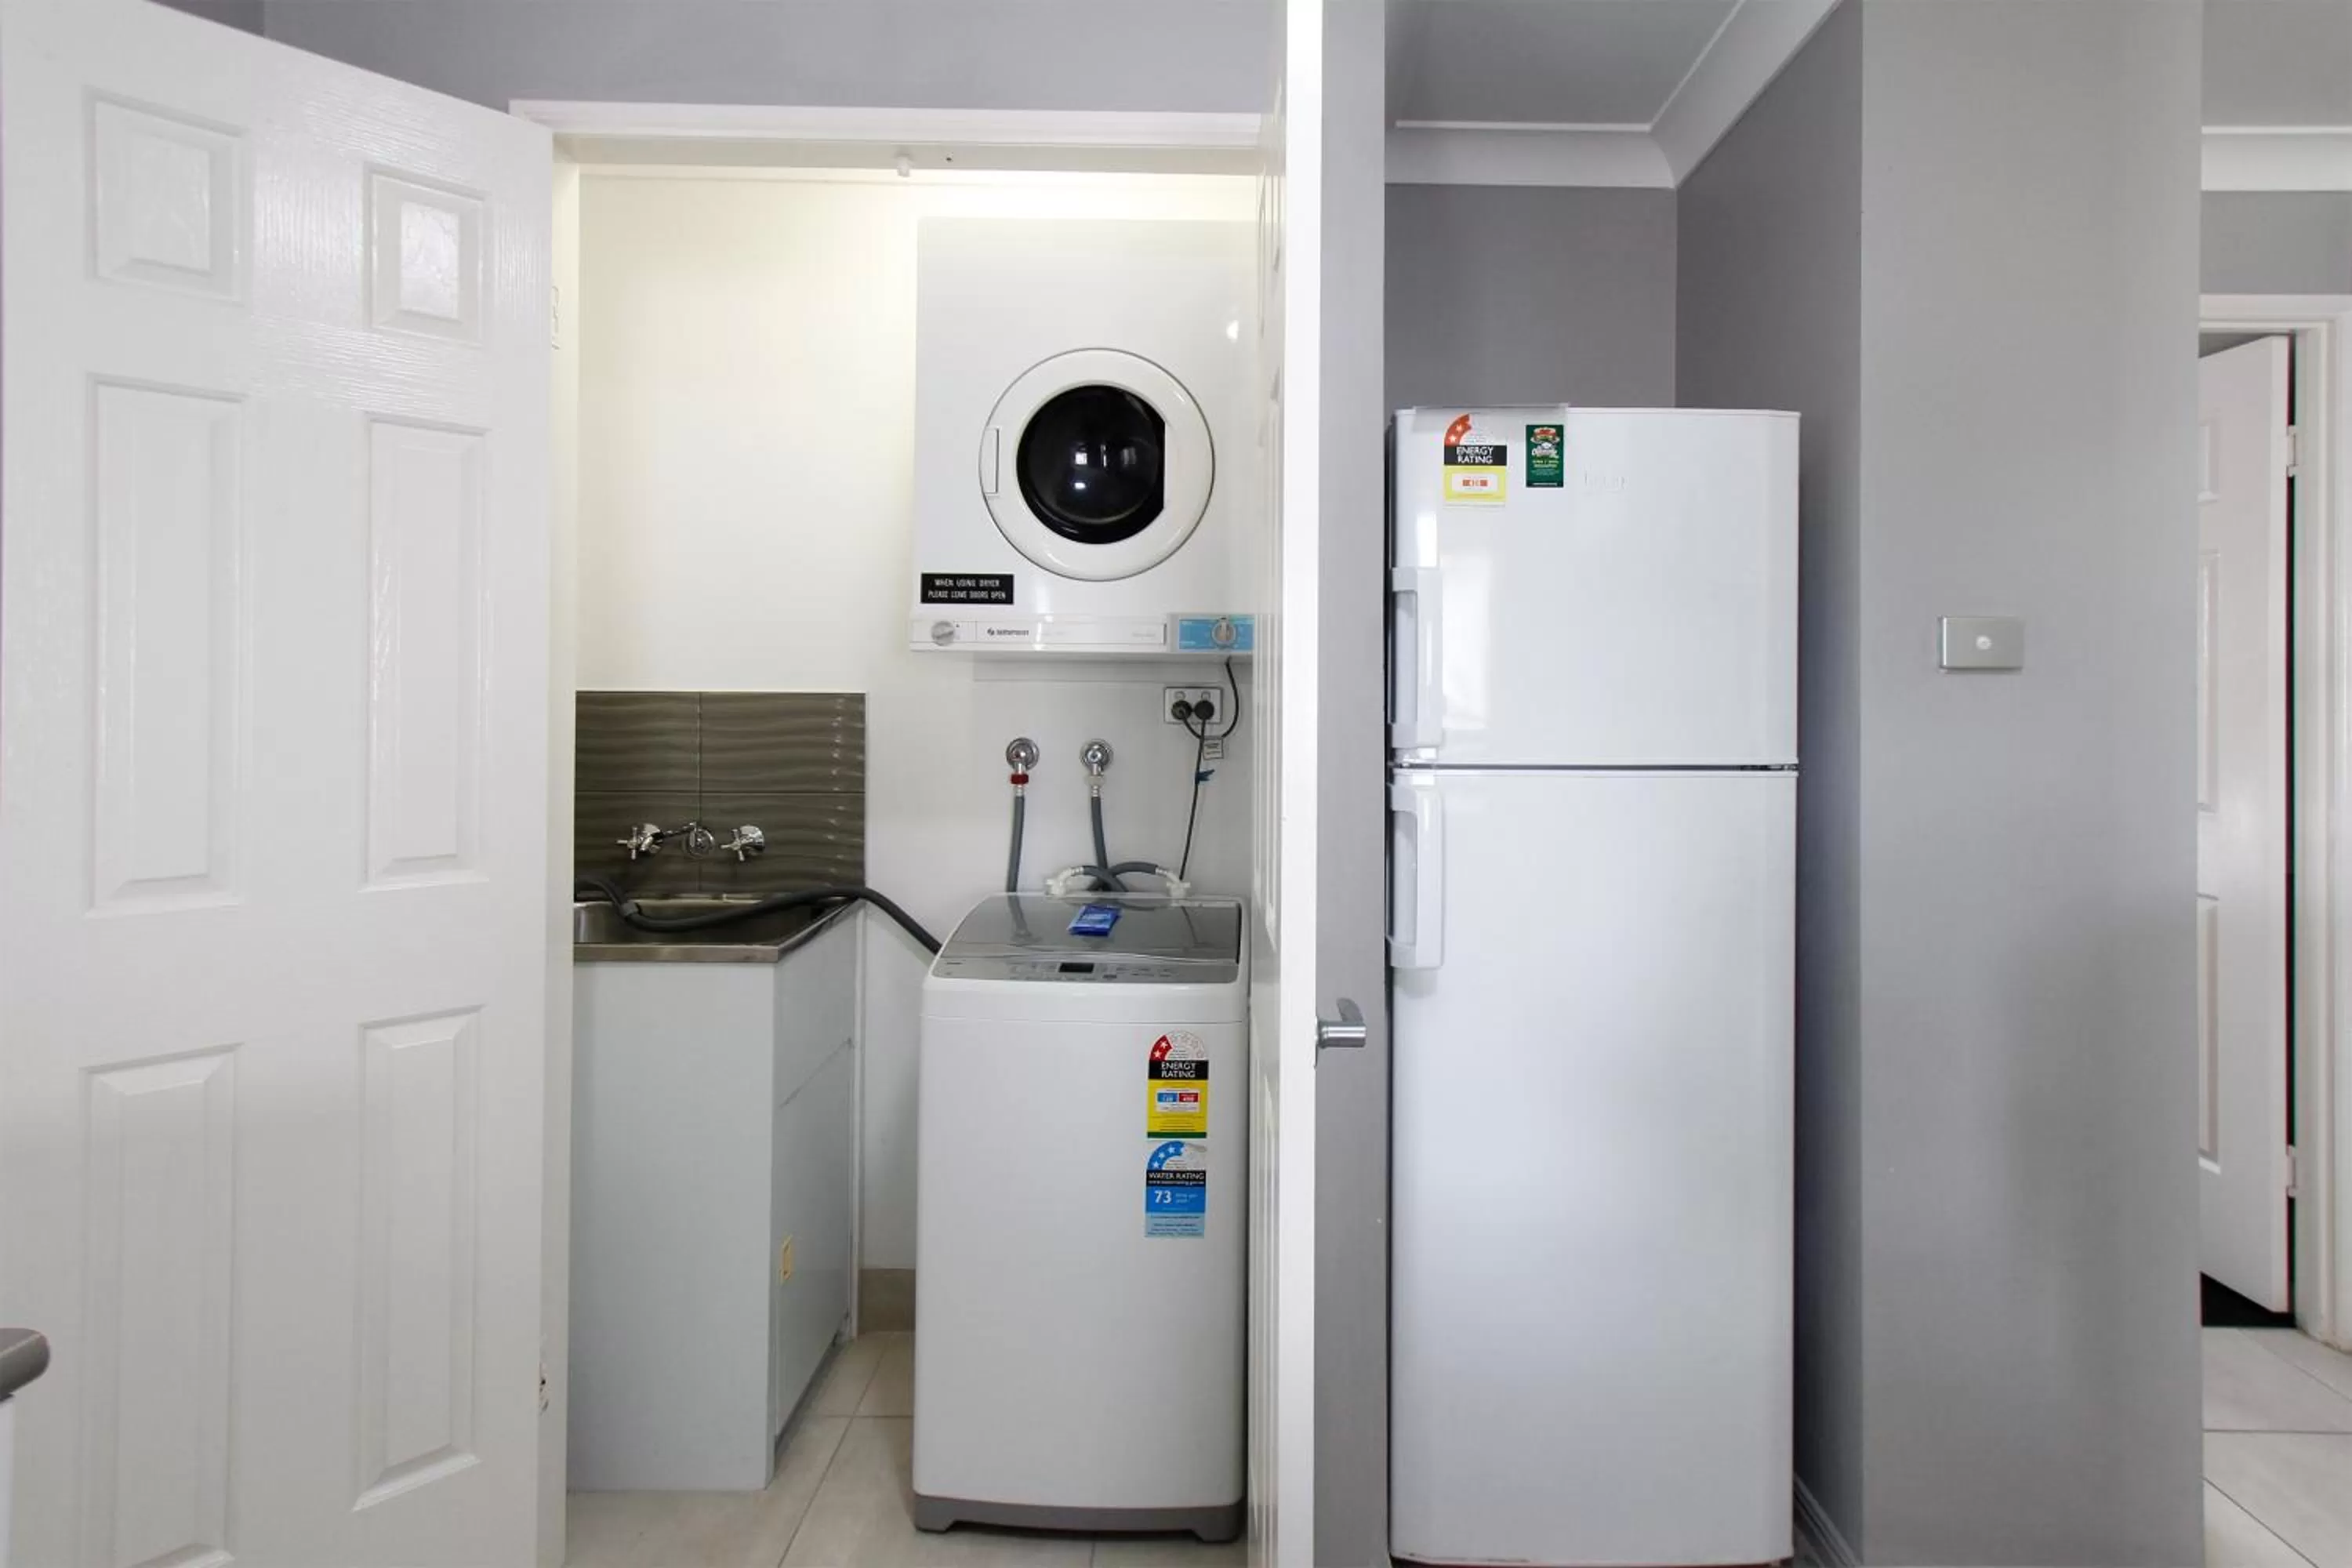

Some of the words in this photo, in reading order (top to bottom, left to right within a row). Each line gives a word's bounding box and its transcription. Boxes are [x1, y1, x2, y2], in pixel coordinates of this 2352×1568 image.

[1456, 446, 1494, 456] ENERGY
[1457, 456, 1494, 464] RATING
[1160, 1062, 1196, 1070] ENERGY
[1153, 1189, 1173, 1204] 73
